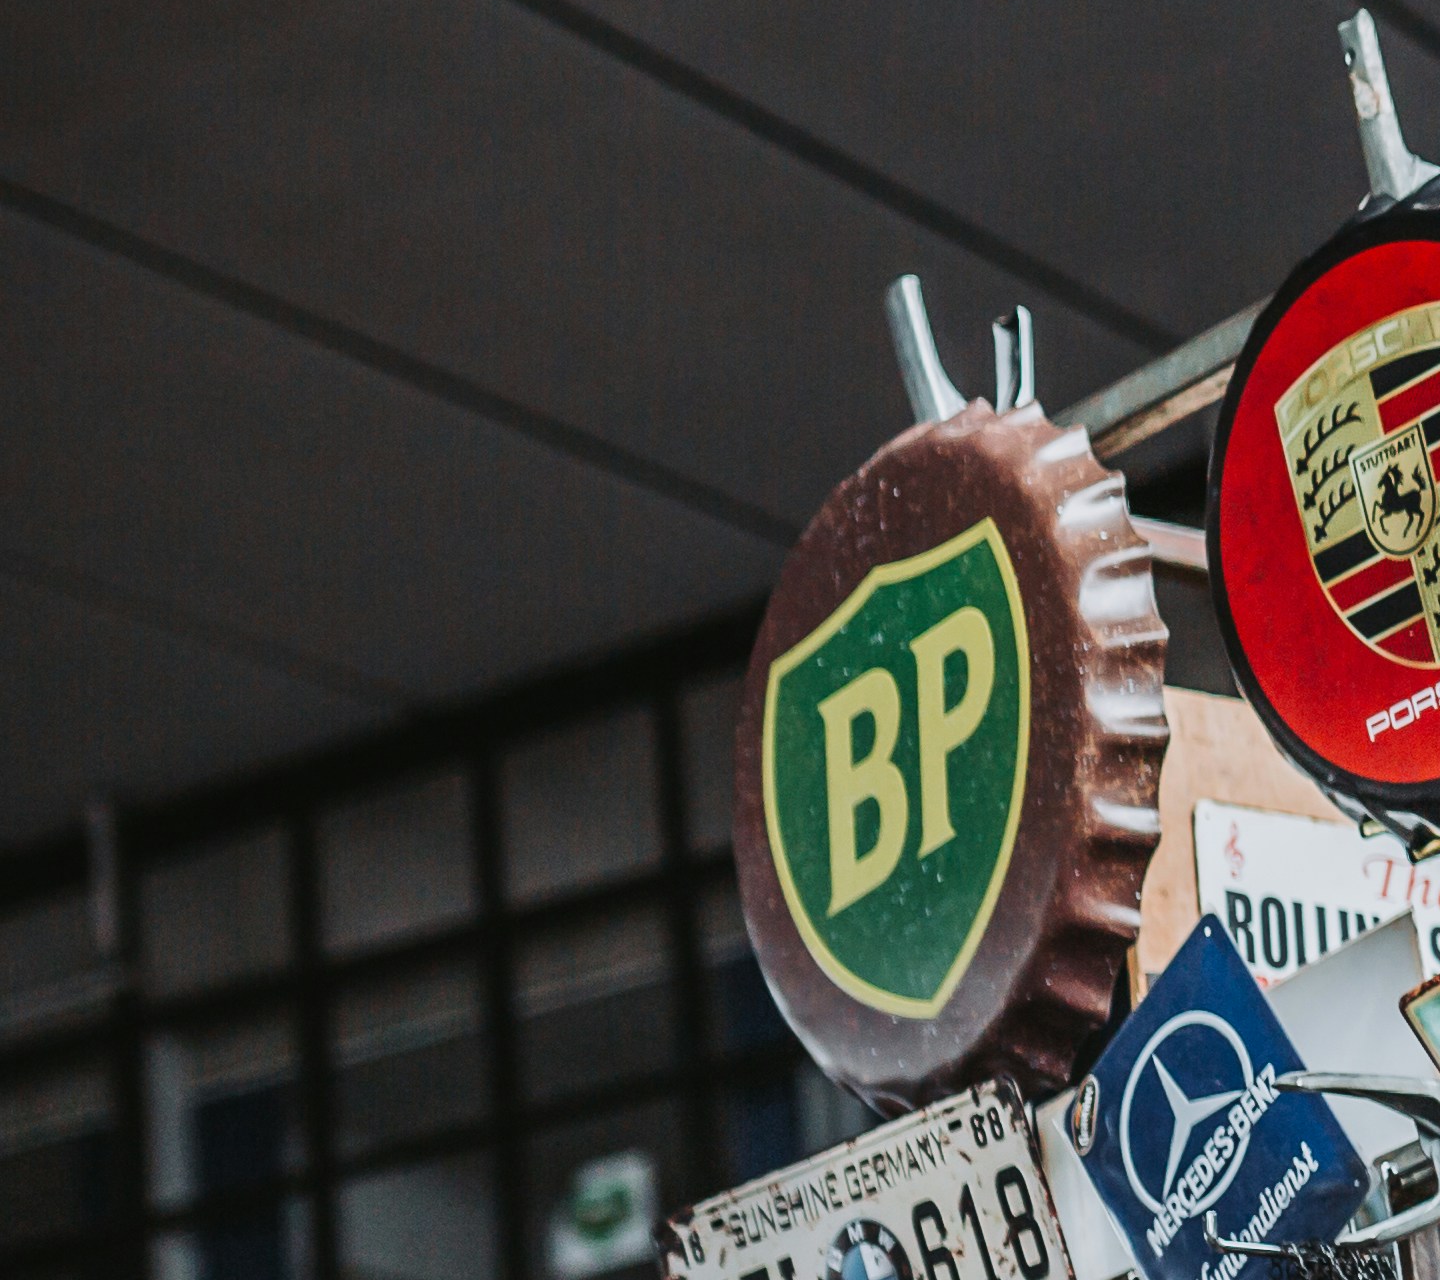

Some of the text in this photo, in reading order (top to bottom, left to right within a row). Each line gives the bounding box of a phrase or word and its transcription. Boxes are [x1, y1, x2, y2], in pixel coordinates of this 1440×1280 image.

[1359, 432, 1418, 476] STUTTGART
[817, 604, 996, 920] BP
[728, 1126, 948, 1249] SUNSHINE GERMANY
[1146, 1061, 1281, 1258] MERCEDES-BENZ
